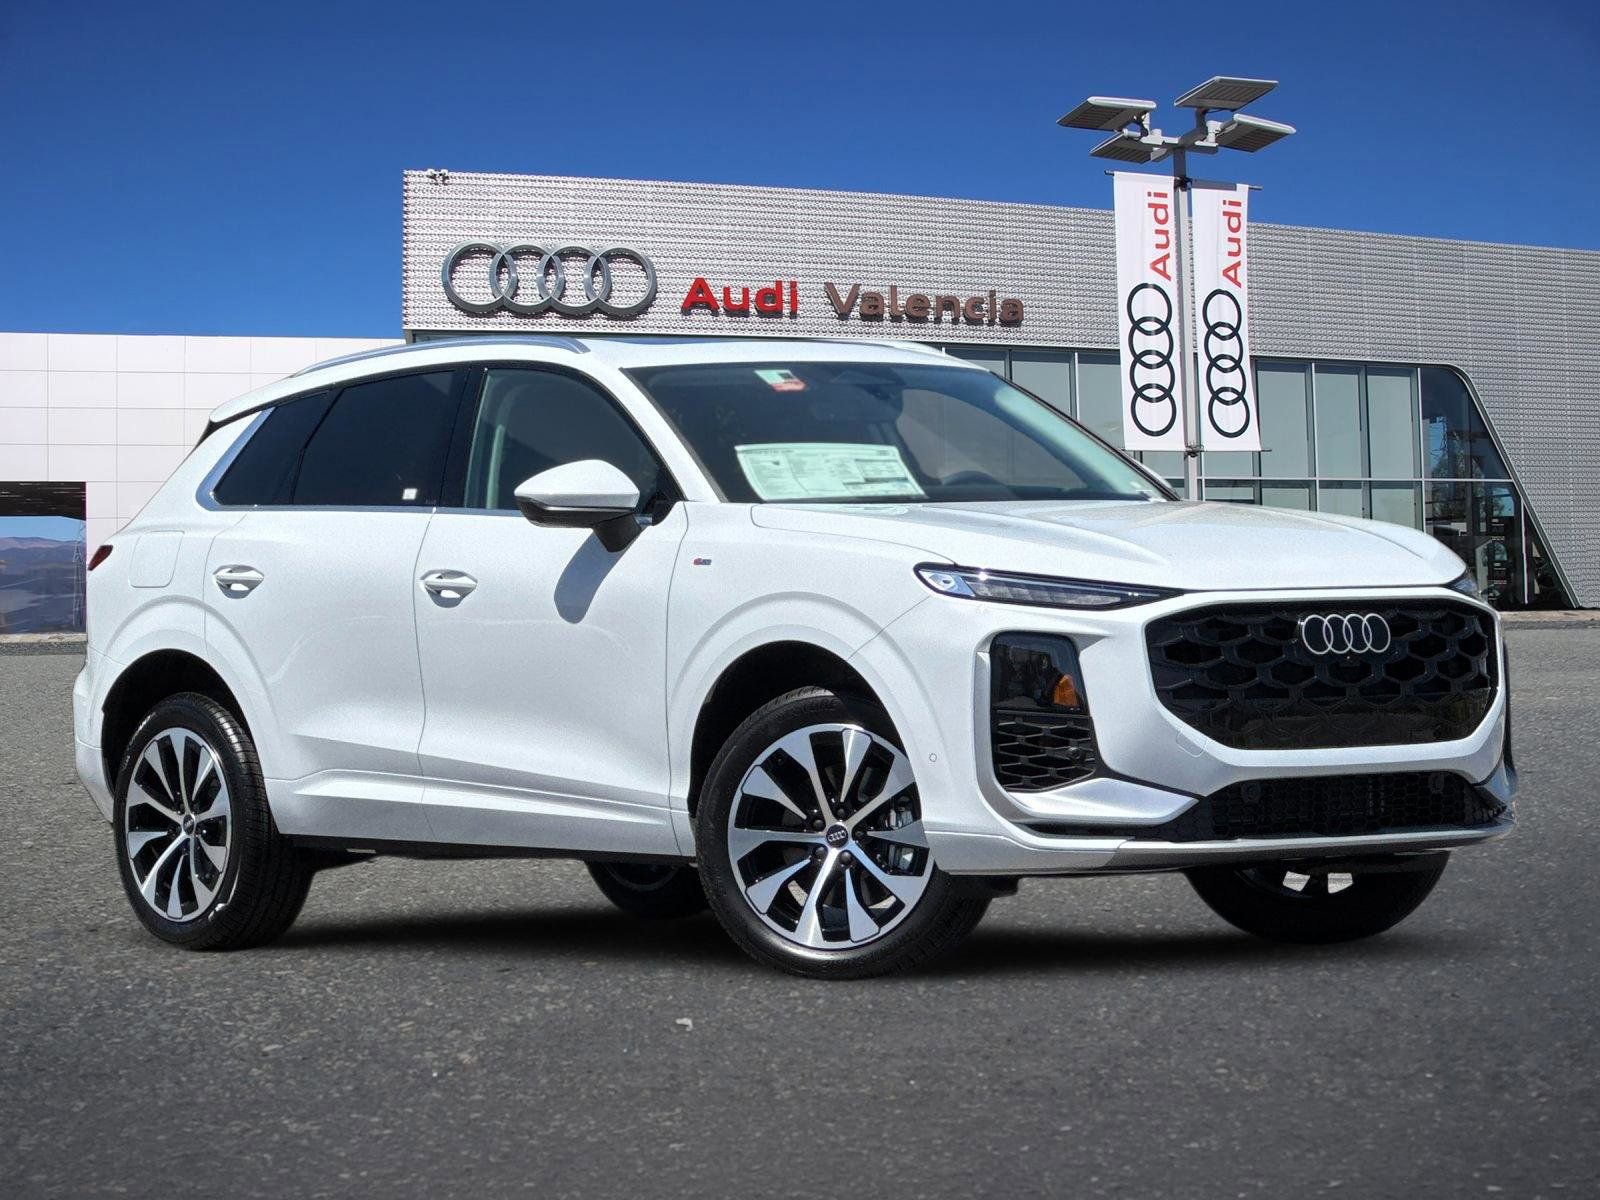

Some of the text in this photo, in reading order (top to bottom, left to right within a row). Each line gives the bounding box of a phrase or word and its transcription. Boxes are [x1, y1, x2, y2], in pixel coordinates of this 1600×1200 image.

[1147, 191, 1172, 282] Audi
[1222, 199, 1242, 289] Audi
[681, 277, 1025, 326] Audi Valencia
